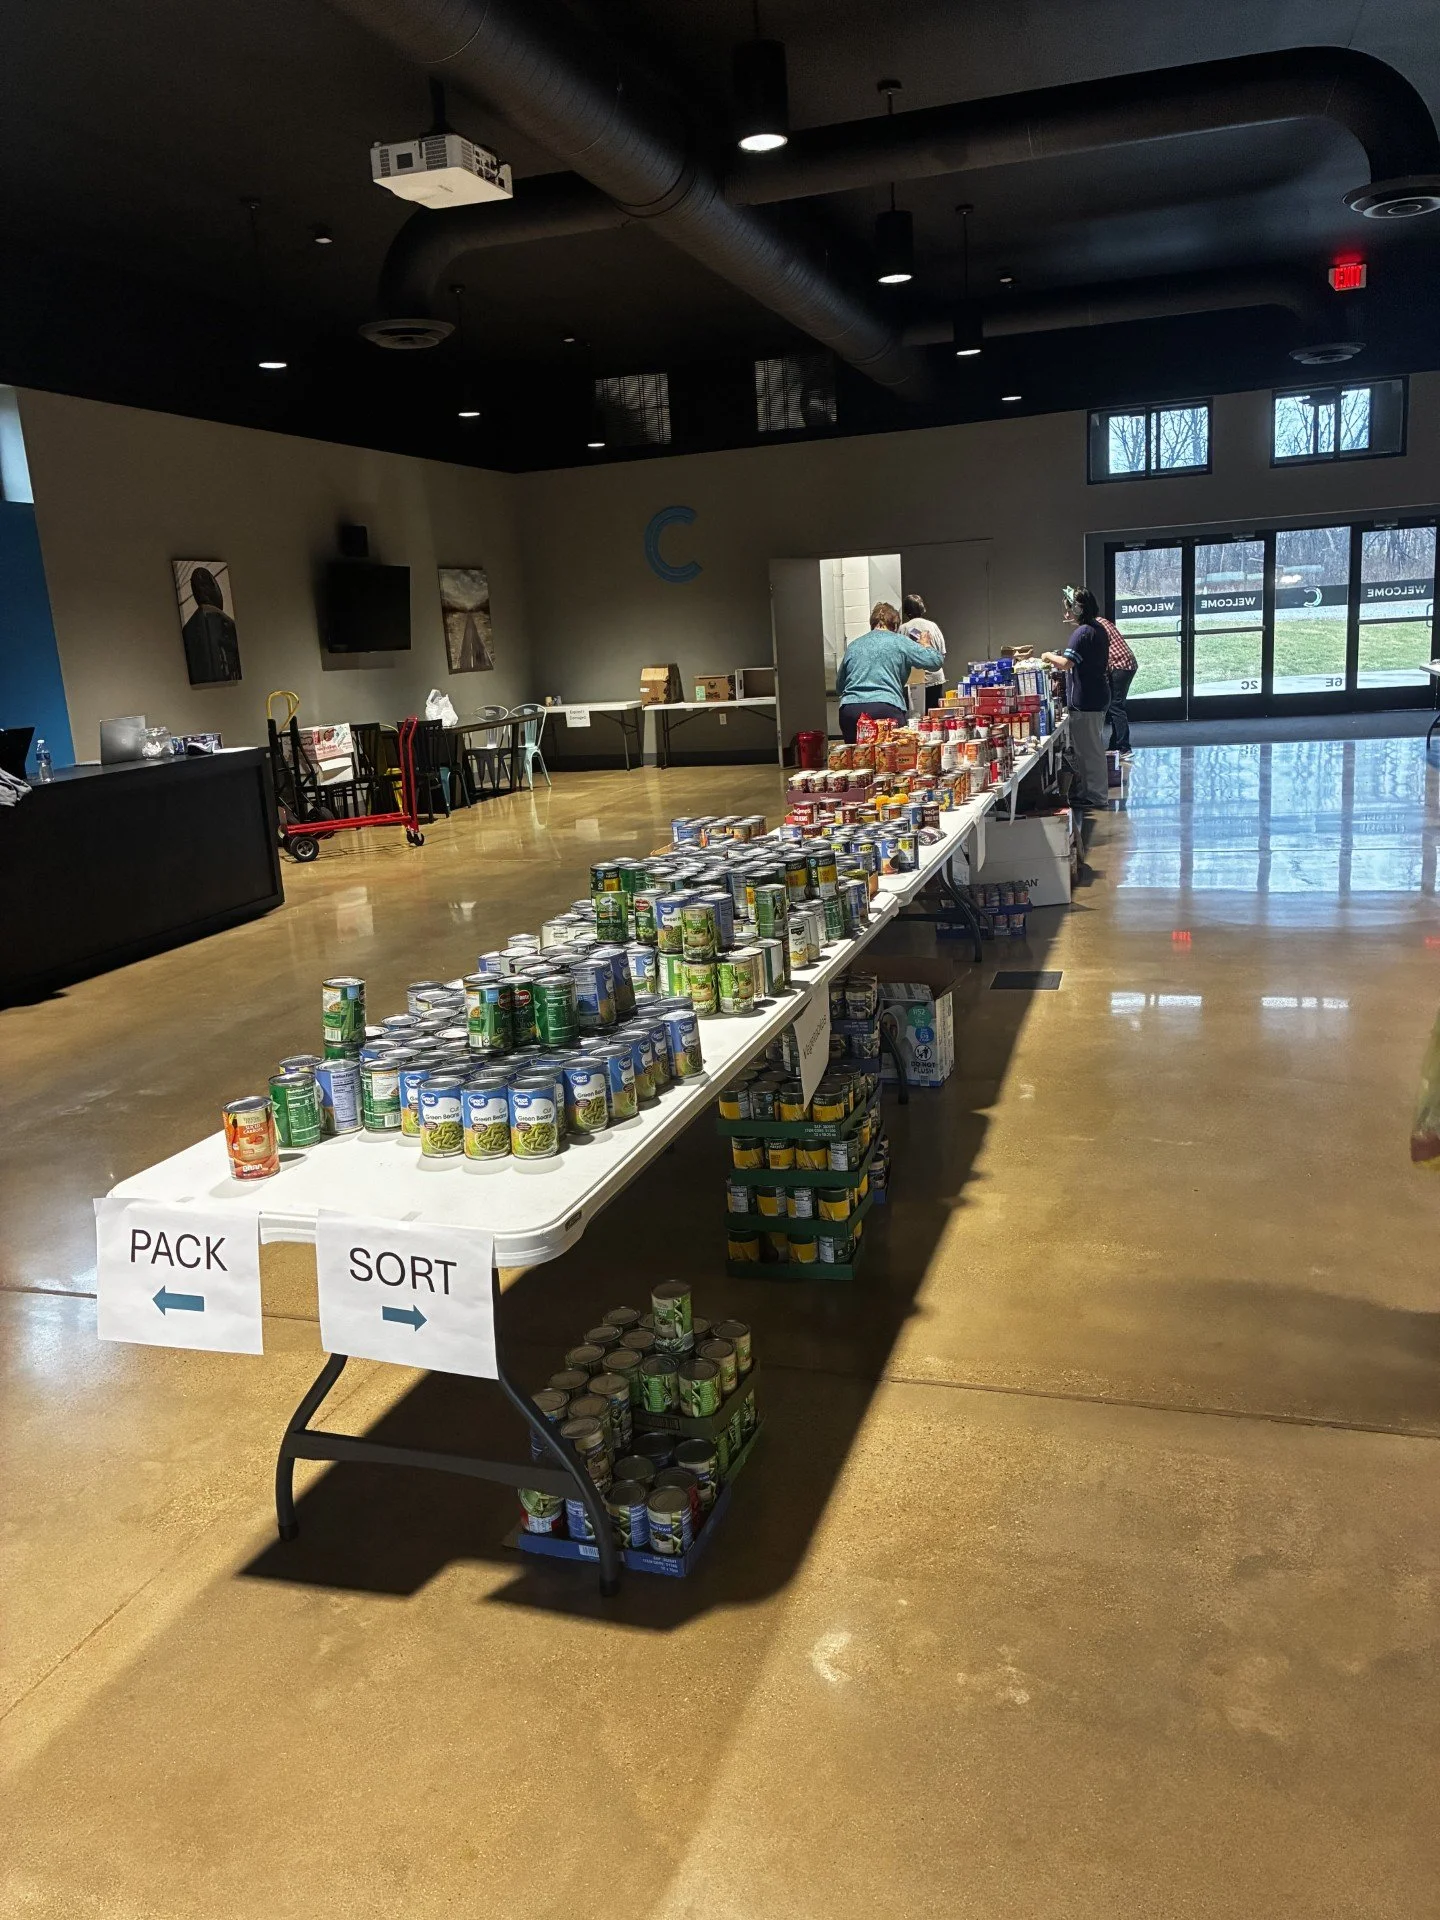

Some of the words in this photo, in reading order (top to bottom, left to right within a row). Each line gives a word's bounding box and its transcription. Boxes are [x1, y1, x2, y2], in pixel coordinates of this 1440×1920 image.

[572, 1073, 588, 1081] Great
[577, 1088, 595, 1099] Green
[514, 1096, 529, 1104] Great
[542, 1106, 553, 1114] Cut
[425, 1112, 443, 1120] Green
[442, 1111, 461, 1120] Beans
[473, 1113, 492, 1122] Green
[492, 1112, 507, 1121] Beans
[517, 1113, 536, 1122] Green
[535, 1113, 553, 1121] Beans
[130, 1228, 228, 1271] PACK
[349, 1247, 457, 1295] SORT
